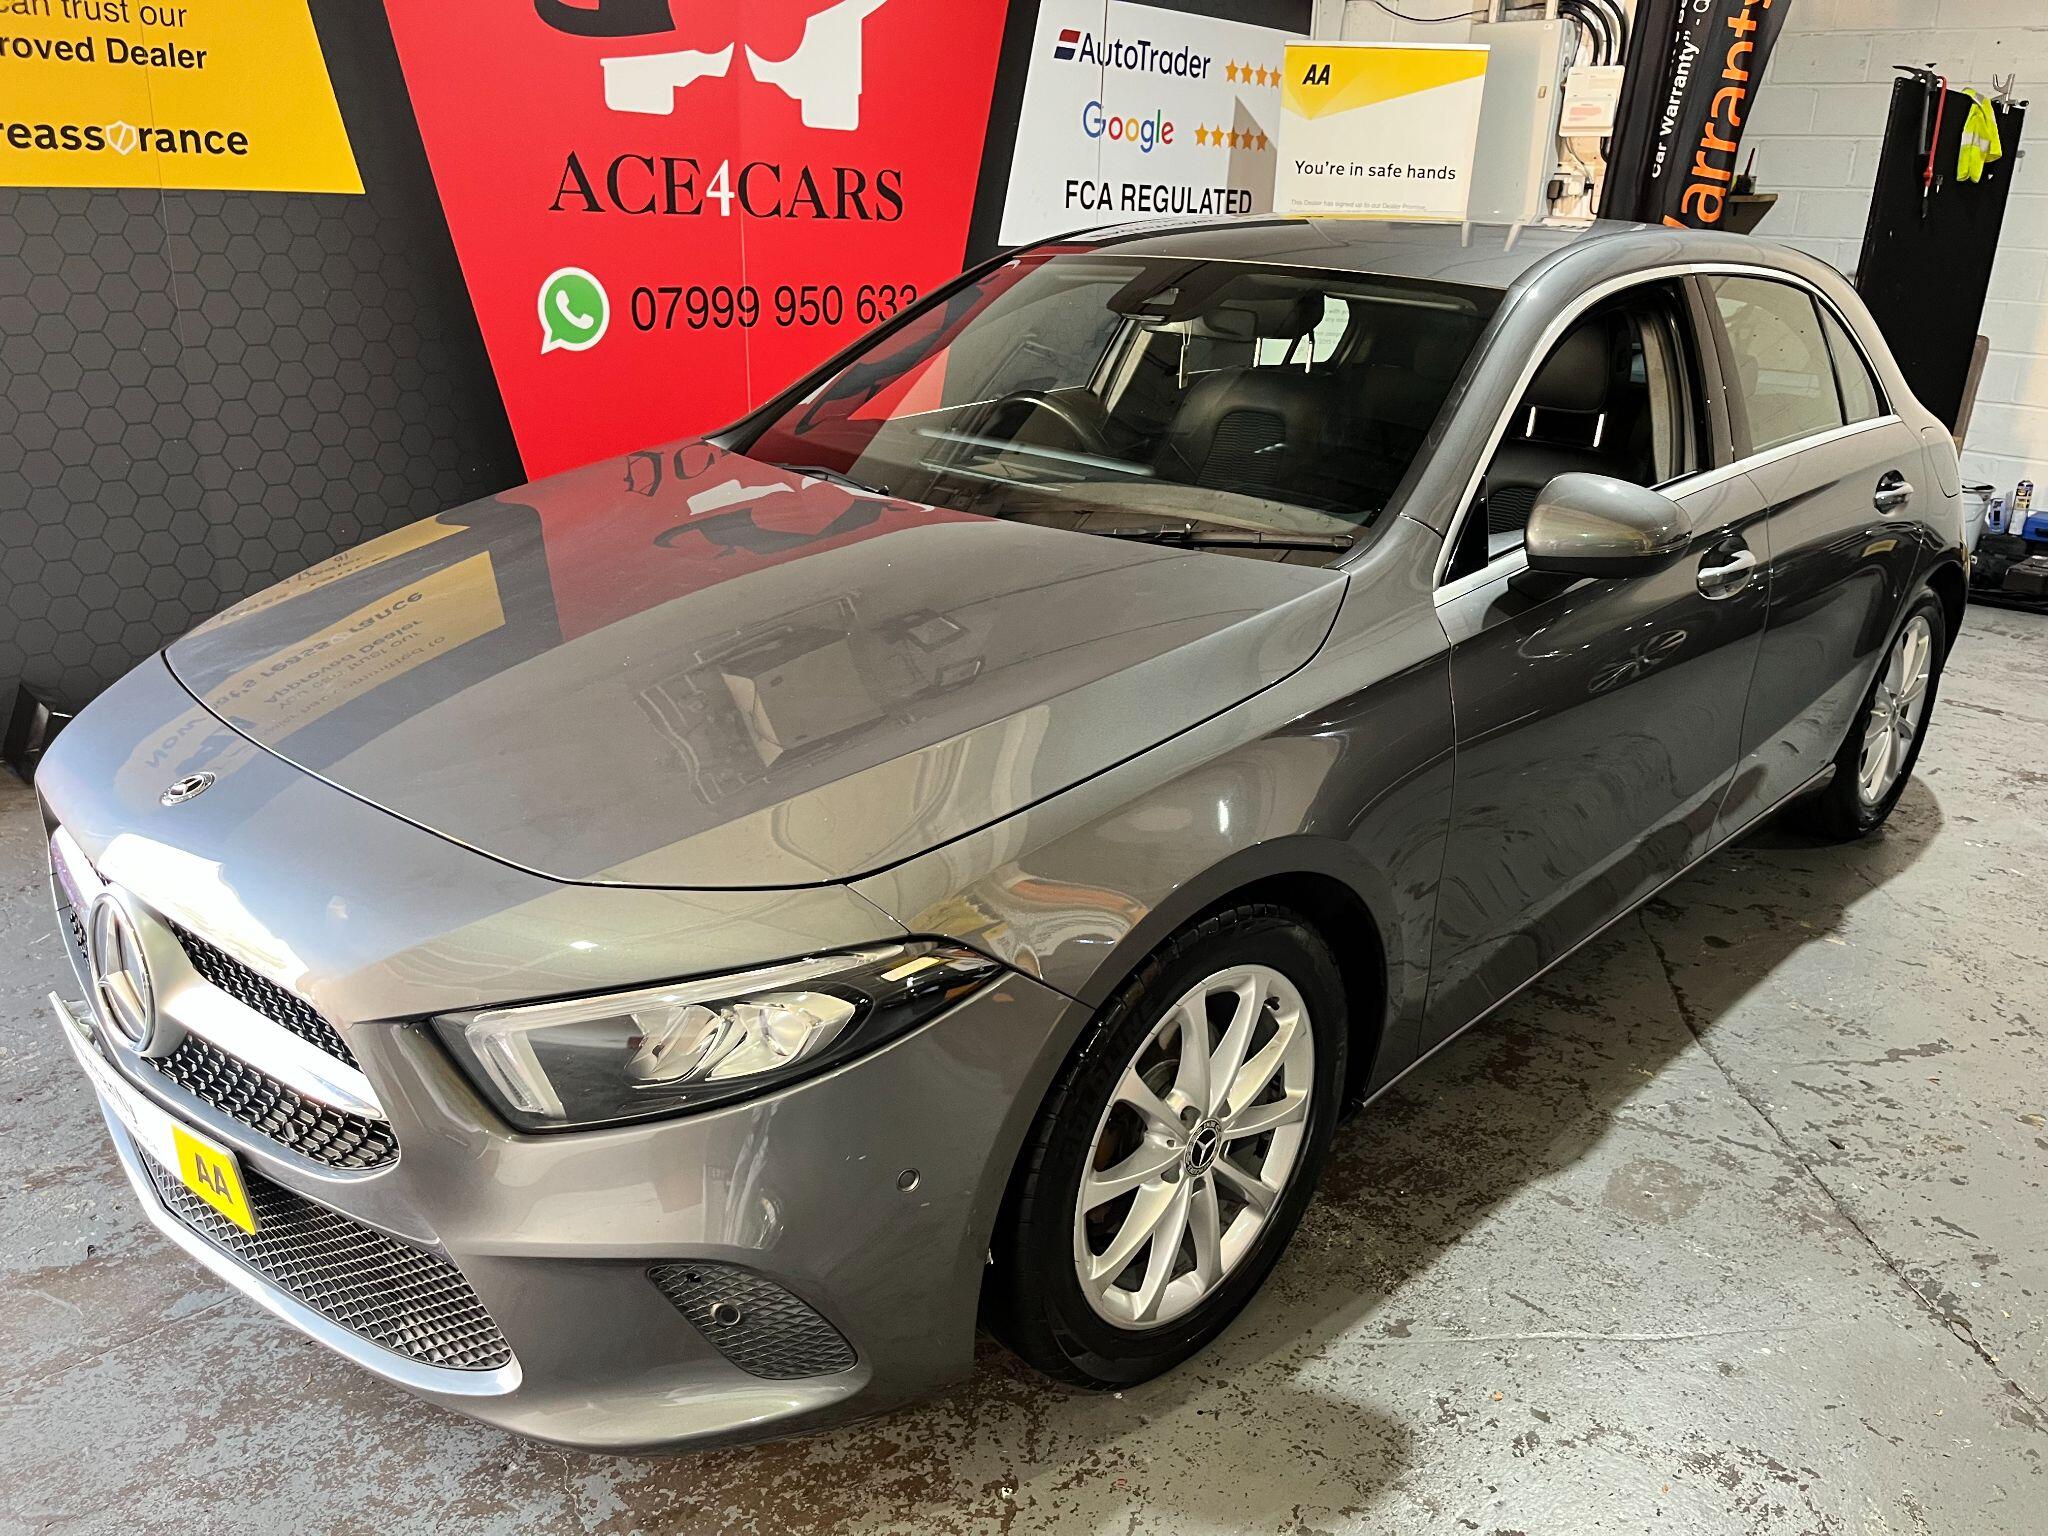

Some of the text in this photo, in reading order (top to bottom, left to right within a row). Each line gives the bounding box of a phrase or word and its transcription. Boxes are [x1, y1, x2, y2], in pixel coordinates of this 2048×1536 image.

[61, 0, 130, 23] trust
[140, 5, 187, 27] our
[106, 37, 207, 69] Dealer
[1078, 33, 1211, 78] AutoTrader
[1302, 63, 1331, 86] AA
[1082, 101, 1174, 153] Google
[549, 150, 904, 222] ACE4CARS
[1350, 162, 1363, 176] in
[1368, 163, 1402, 178] safe
[1407, 164, 1456, 180] hands
[1065, 179, 1252, 215] FCA REGULATED
[631, 285, 760, 331] 07999
[774, 285, 844, 326] 950
[195, 1153, 233, 1205] AA
